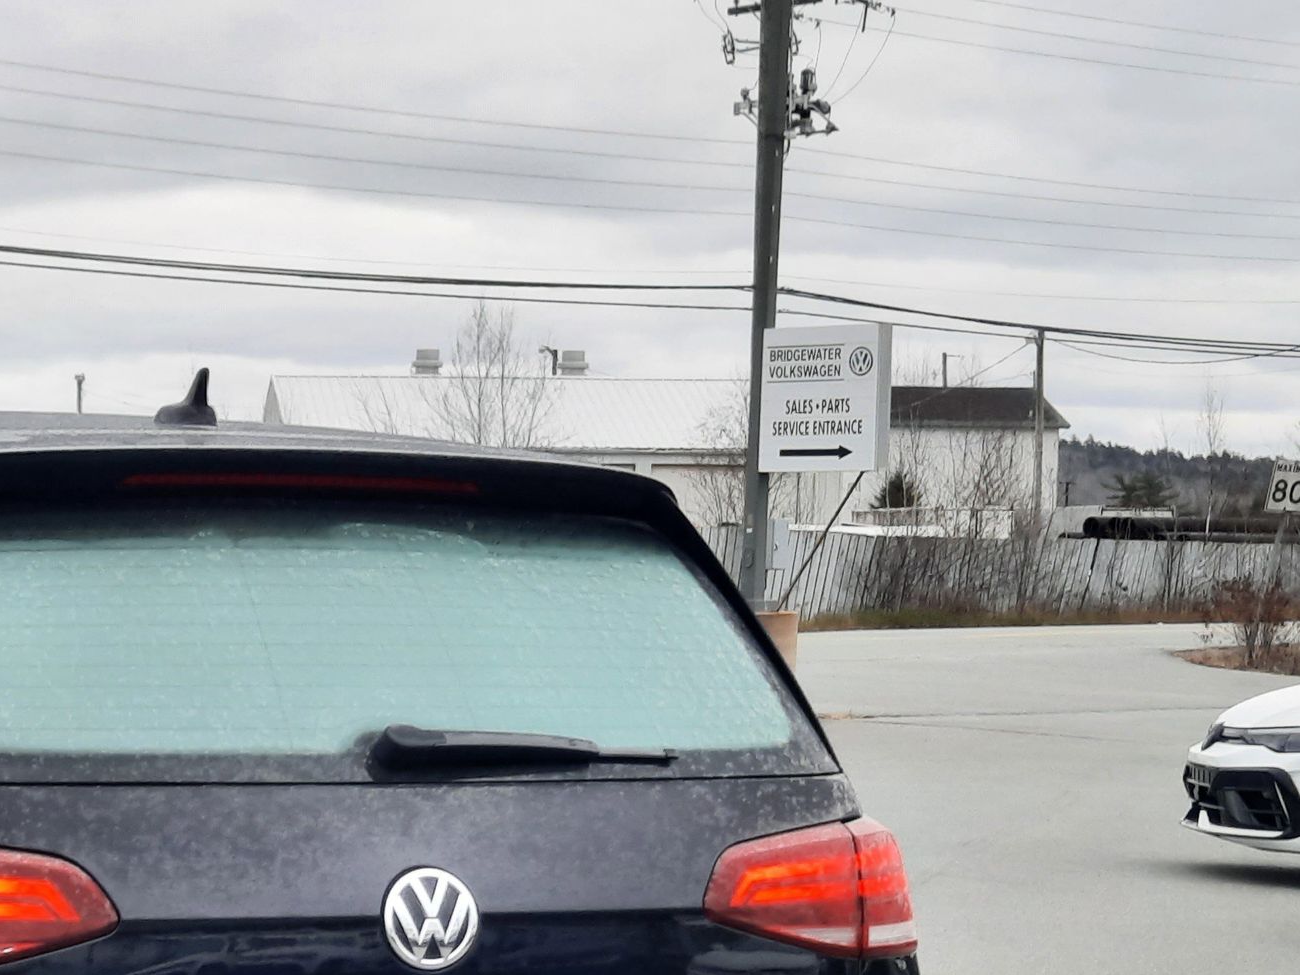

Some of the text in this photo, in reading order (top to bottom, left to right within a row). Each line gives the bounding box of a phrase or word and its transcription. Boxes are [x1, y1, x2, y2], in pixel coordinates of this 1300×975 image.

[769, 347, 842, 362] BRIDGEWATER
[769, 364, 841, 379] VOLKSWAGEN
[785, 398, 850, 415] SALES PARTS
[772, 419, 863, 436] SERVICE ENTRANCE
[383, 866, 479, 971] VW
